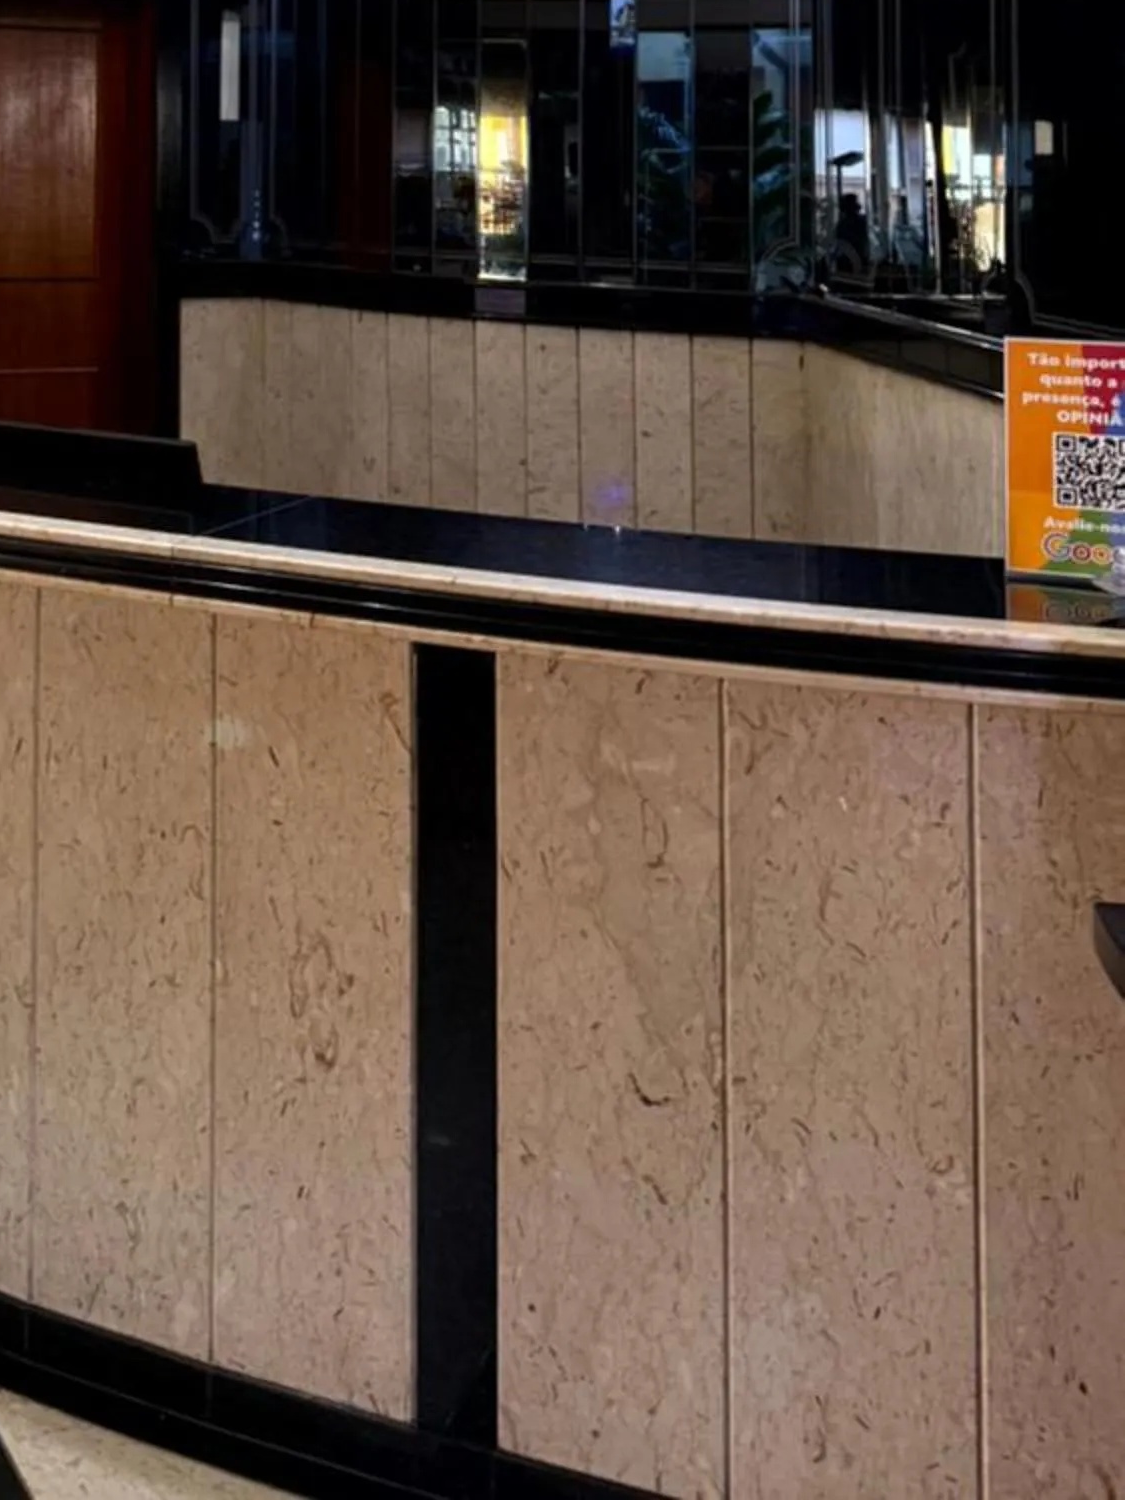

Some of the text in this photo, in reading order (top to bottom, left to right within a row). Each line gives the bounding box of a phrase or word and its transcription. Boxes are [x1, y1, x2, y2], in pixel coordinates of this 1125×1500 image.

[1027, 352, 1061, 367] Tão
[1039, 374, 1118, 389] quanto a
